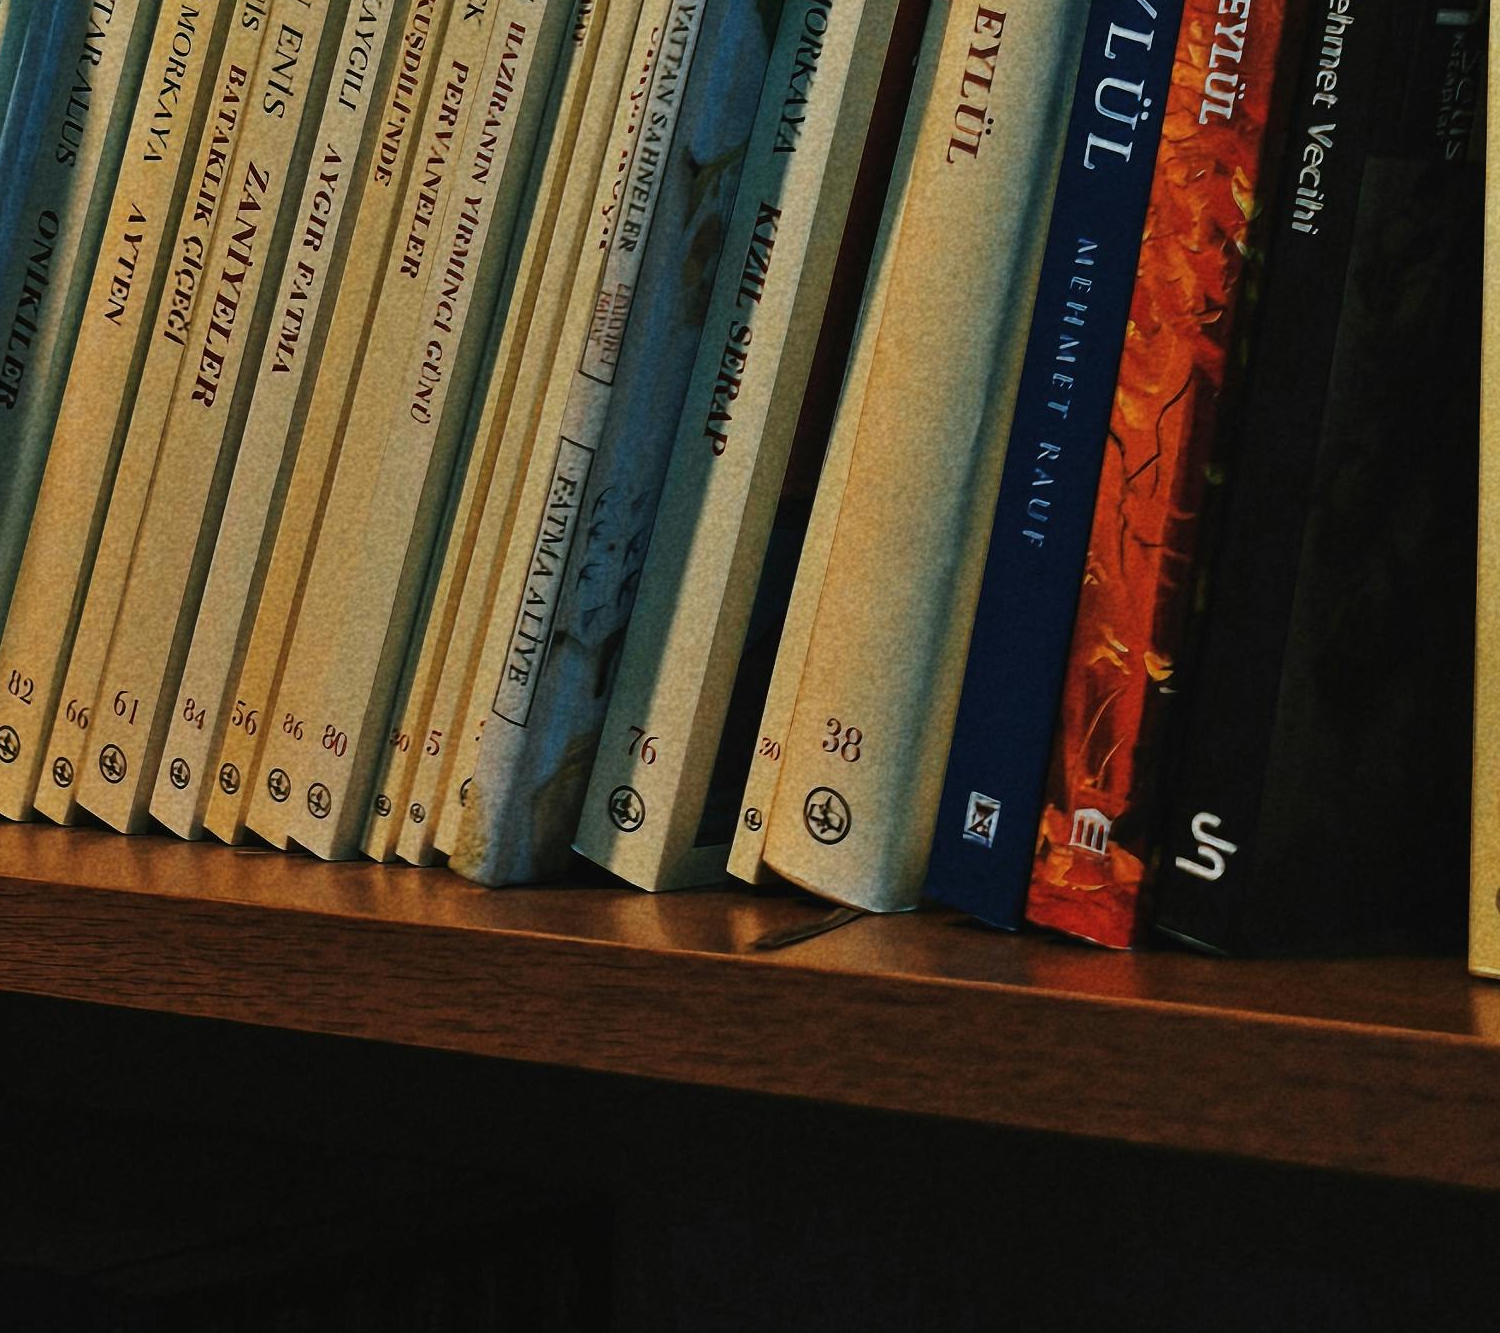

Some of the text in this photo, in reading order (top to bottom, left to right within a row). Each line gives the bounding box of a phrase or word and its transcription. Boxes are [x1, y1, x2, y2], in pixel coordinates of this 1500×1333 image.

[56, 69, 90, 167] ALUS
[144, 4, 200, 163] MORKAYA
[261, 24, 304, 119] ENİS
[947, 5, 1008, 166] EYLÜL
[163, 64, 246, 347] BATAKLIK ÇİÇEĞİ
[303, 143, 342, 252] AYGIR
[400, 60, 469, 279] PERVANELER
[1290, 123, 1339, 234] Vecihi
[104, 203, 147, 327] AYTEN
[191, 160, 269, 407] ZANİYELER
[271, 261, 315, 374] FATMA
[407, 337, 440, 424] GÜNÜ
[703, 201, 780, 456] KIZIL SERAP
[1045, 237, 1099, 420] MEHMET
[1020, 442, 1060, 553] RAUF
[6, 669, 36, 705] 82
[112, 690, 140, 725] 61
[820, 717, 863, 764] 38
